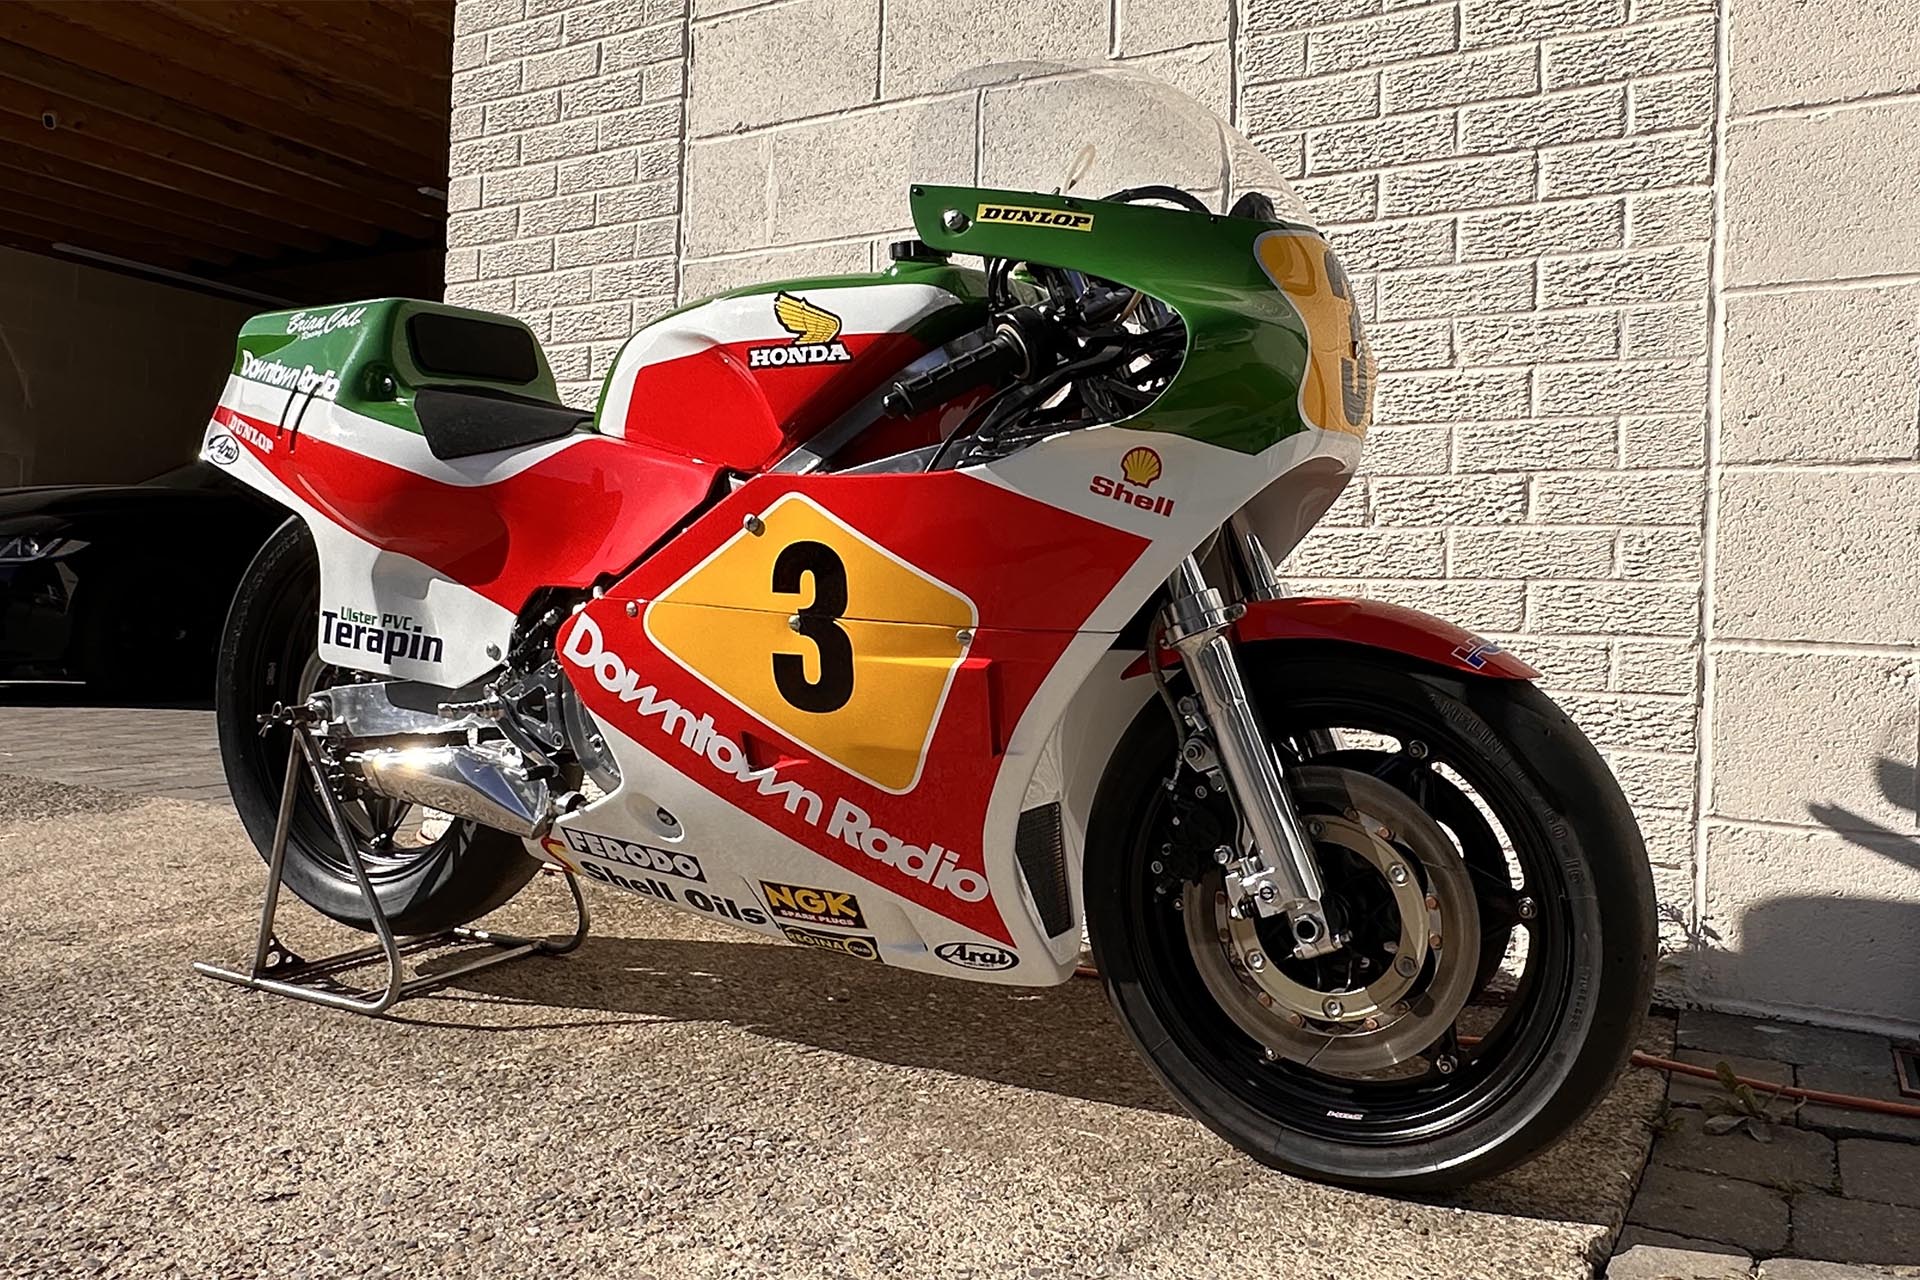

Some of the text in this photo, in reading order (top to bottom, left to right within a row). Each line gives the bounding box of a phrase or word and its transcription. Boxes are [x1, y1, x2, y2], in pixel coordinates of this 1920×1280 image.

[979, 206, 1091, 229] DUNLOP
[286, 307, 367, 334] Brian Coll
[240, 349, 301, 391] Downtown
[749, 343, 851, 367] HONDA
[228, 414, 275, 455] DUNLOP
[1089, 475, 1175, 517] Shell
[341, 606, 413, 631] Ulster PVC
[771, 540, 855, 714] 3
[321, 610, 444, 666] Terapin
[561, 611, 991, 903] Downtown Radio
[565, 829, 701, 879] FERODO
[579, 860, 768, 925] Shell Oils
[764, 884, 858, 918] NGK
[780, 909, 855, 926] SPARK PLUGS
[786, 931, 844, 950] REGINA
[943, 942, 1010, 965] Arai
